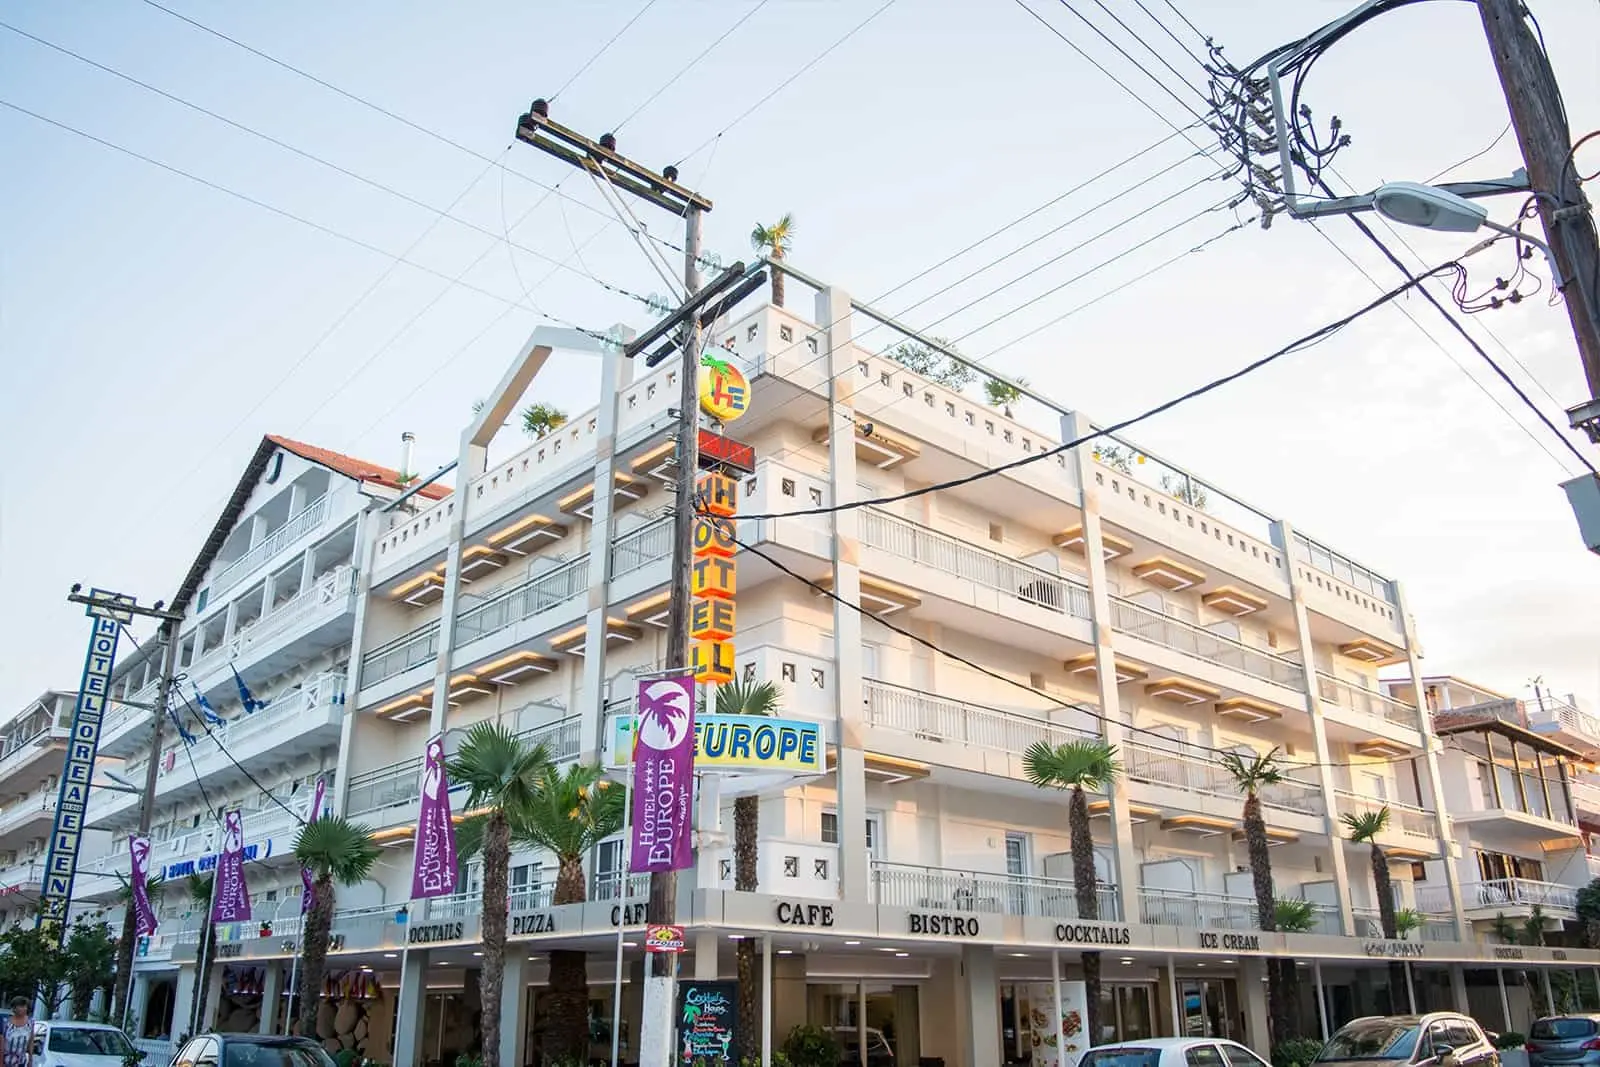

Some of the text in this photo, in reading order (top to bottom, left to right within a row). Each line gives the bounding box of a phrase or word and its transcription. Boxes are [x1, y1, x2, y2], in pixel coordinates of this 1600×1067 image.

[713, 476, 737, 675] HOTEL
[84, 619, 115, 712] HOTEL
[67, 724, 94, 801] OREA
[640, 793, 656, 846] HOTEL
[648, 758, 675, 866] EUROPE
[222, 857, 240, 920] EUROPE
[409, 922, 463, 943] OCKTAILS
[512, 913, 555, 935] PIZZA
[777, 902, 834, 928] CAFE
[910, 913, 980, 937] BISTRO
[1056, 924, 1130, 945] COCKTAILS
[1200, 932, 1260, 951] ICE CREAM
